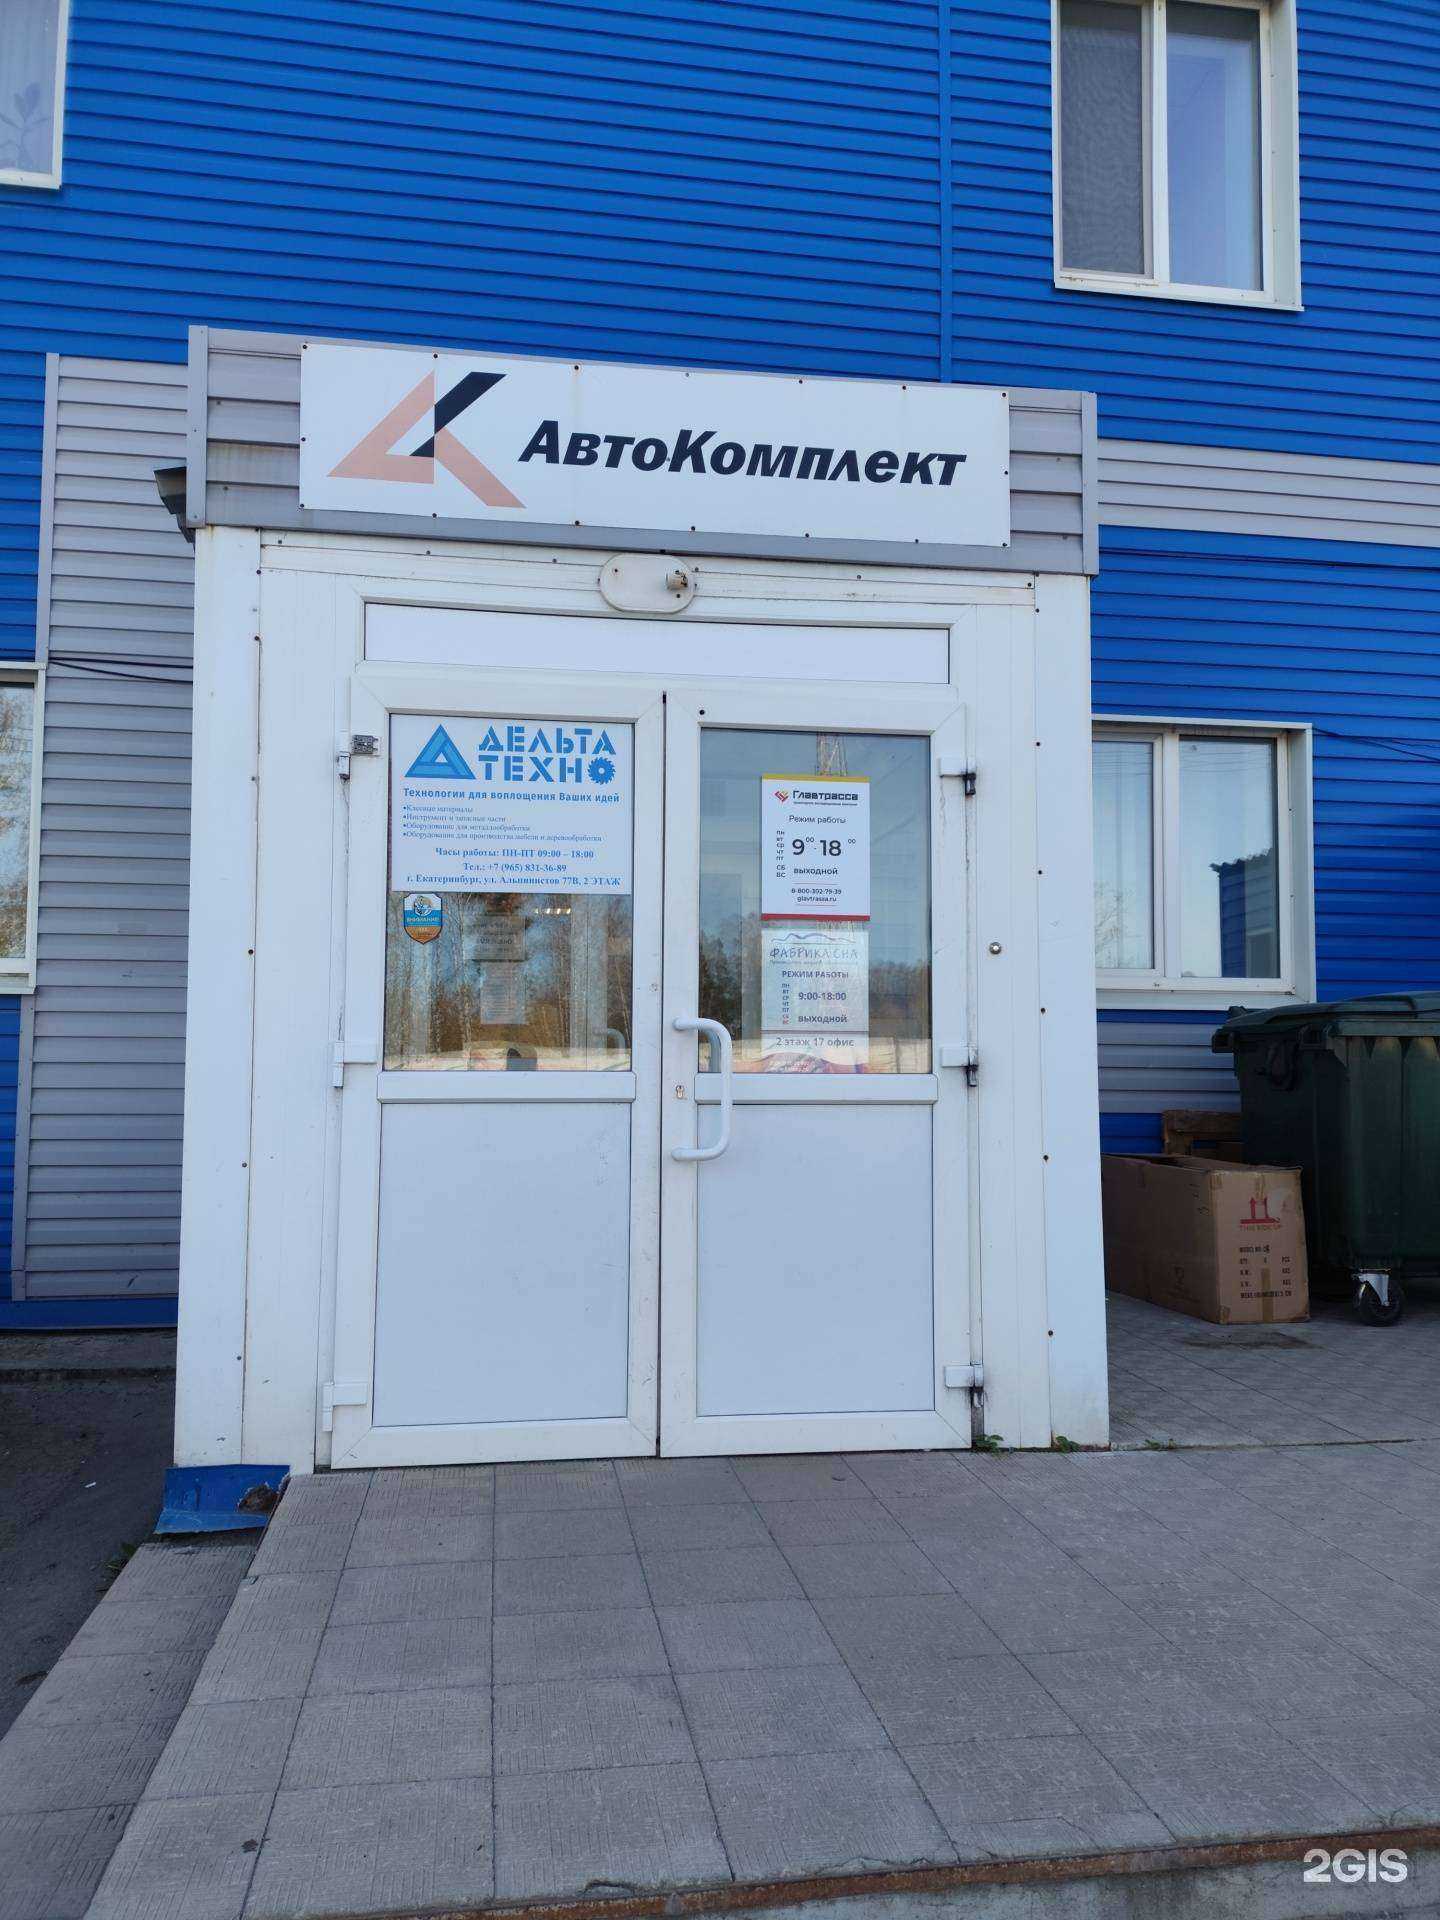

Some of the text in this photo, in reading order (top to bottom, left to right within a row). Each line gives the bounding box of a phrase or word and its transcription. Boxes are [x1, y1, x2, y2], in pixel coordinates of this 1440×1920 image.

[518, 420, 967, 487] АвтоКомплект
[478, 725, 616, 755] ДЕЛЬТА
[404, 788, 620, 804] Технологии для воплощения Ваших идей
[792, 790, 859, 801] Главтрасса
[789, 814, 847, 825] Режим работы
[406, 822, 454, 831] Оборудование
[406, 831, 454, 840] Оборудование
[435, 847, 460, 856] Часы
[462, 848, 499, 858] работы:
[502, 848, 535, 857] ПН-ПТ
[537, 849, 561, 858] 09:00
[571, 850, 594, 858] 18:00
[792, 839, 805, 856] 9
[819, 839, 842, 856] 18
[463, 862, 567, 873] Тел.: +7 (965) 831-36-89
[416, 874, 482, 885] Екатеринбург,
[483, 876, 497, 885] ул.
[500, 876, 560, 886] Альпинистов
[583, 877, 589, 885] 2
[591, 877, 621, 886] ЭТАЖ
[769, 946, 830, 959] ФАБРИКА
[781, 970, 849, 979] РЕЖИМ РАБОТЫ
[798, 991, 847, 1001] 9:00-18:00
[776, 1037, 855, 1047] 2 этаж 17 офис
